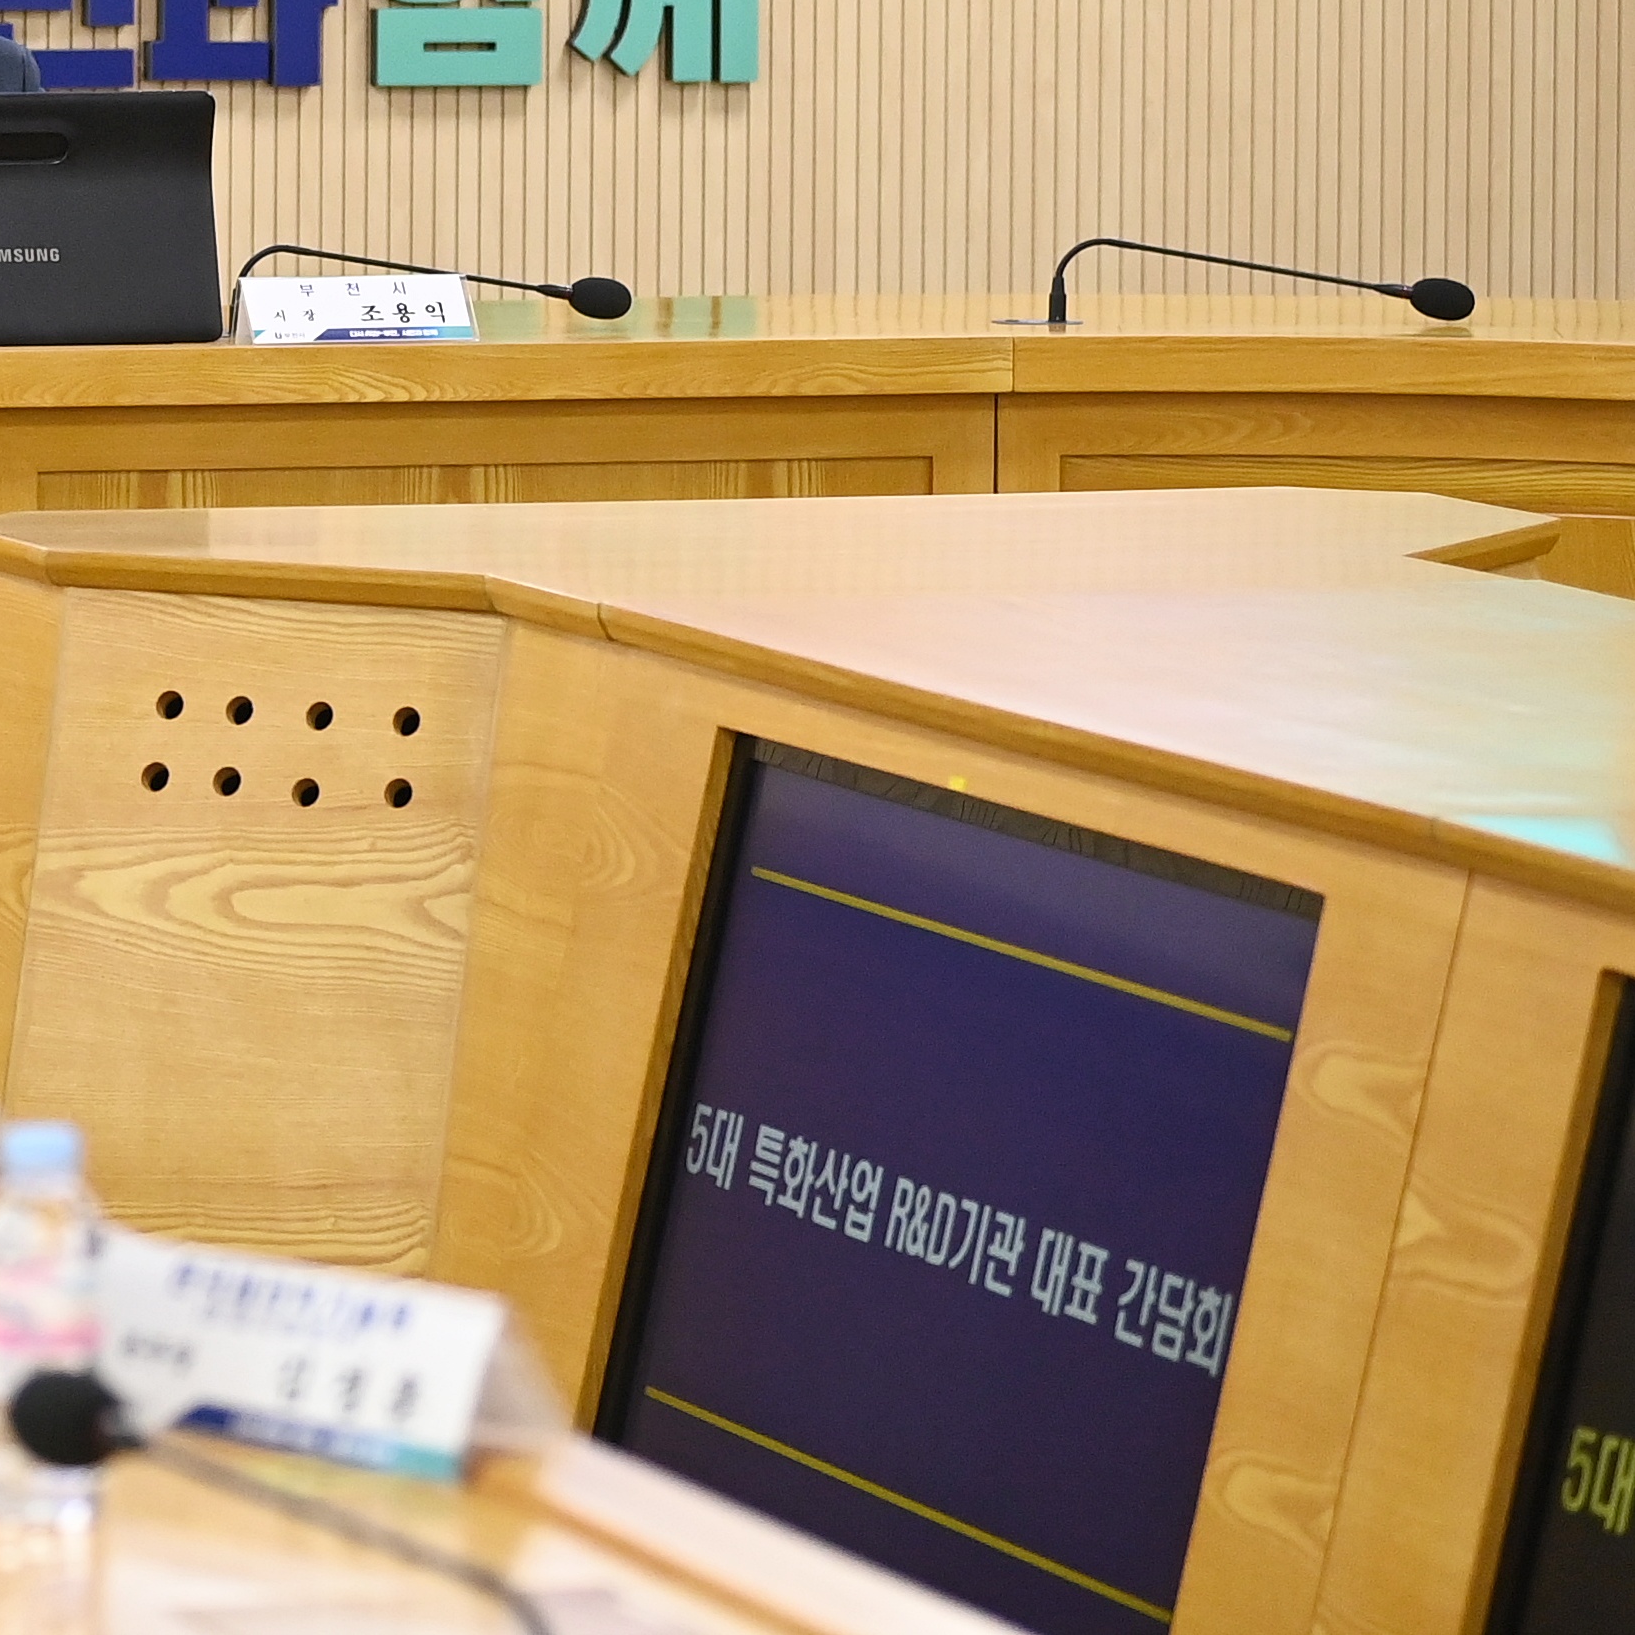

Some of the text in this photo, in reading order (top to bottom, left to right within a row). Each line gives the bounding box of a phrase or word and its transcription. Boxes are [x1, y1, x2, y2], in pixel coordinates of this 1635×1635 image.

[360, 302, 446, 324] 조용익
[686, 1102, 1233, 1378] 5대 특화산업 R&D기관 대표 간담회
[1561, 1426, 1635, 1536] 5대
